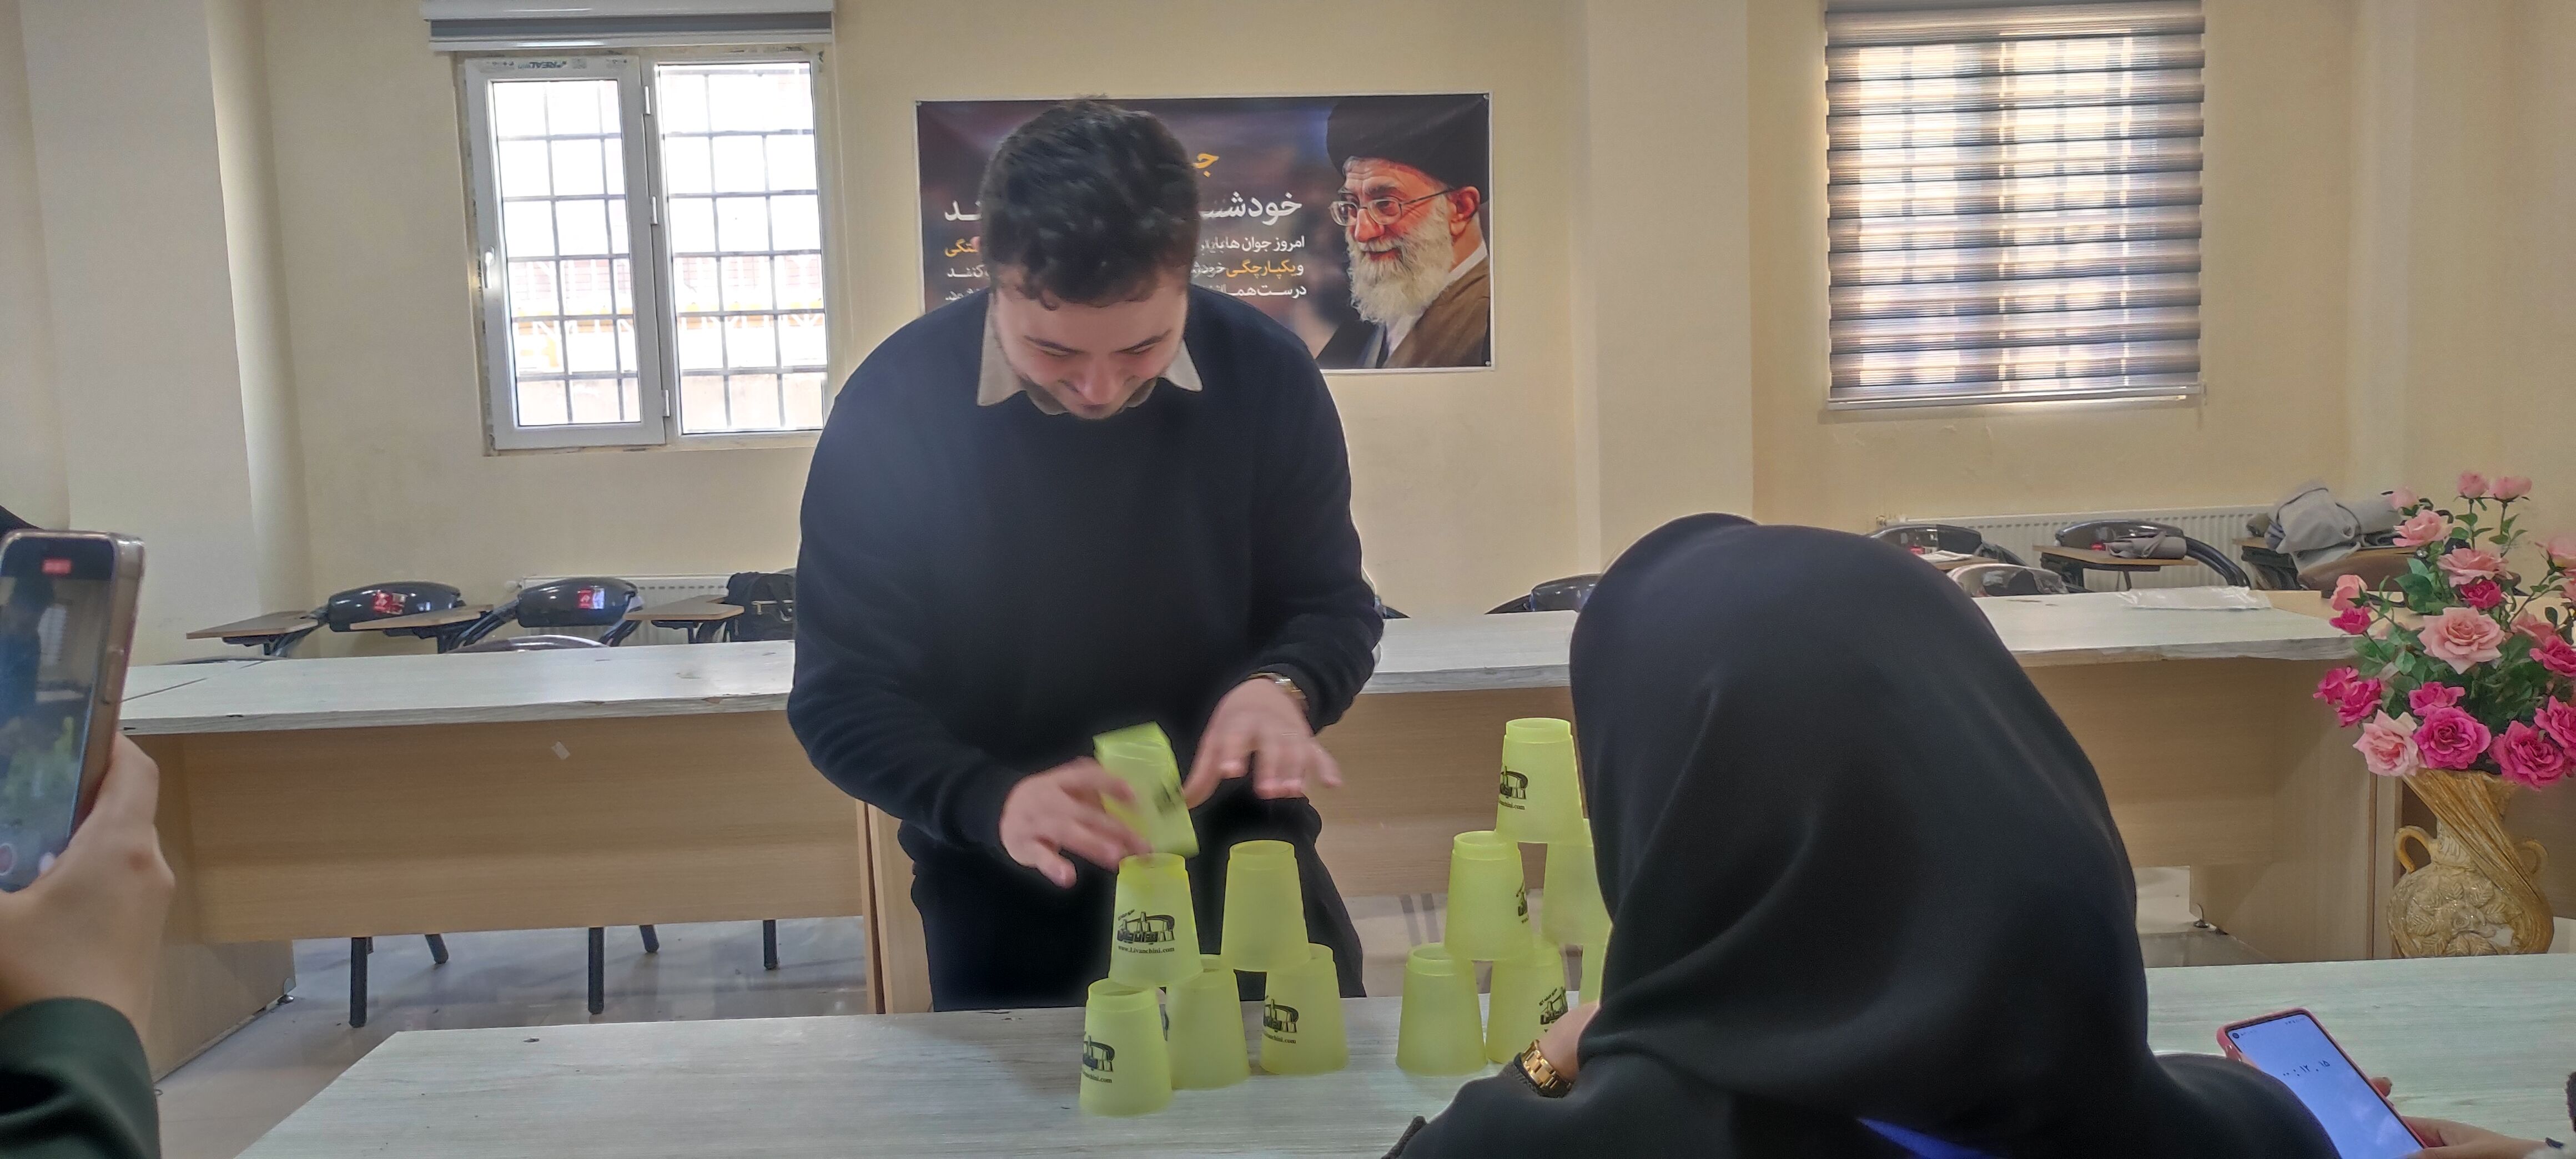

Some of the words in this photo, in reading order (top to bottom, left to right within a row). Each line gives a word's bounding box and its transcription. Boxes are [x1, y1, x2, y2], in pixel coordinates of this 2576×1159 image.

[1198, 191, 1303, 226] خودش
[1241, 236, 1272, 253] جوان
[1272, 235, 1305, 253] امروز
[1257, 285, 1307, 299] درست
